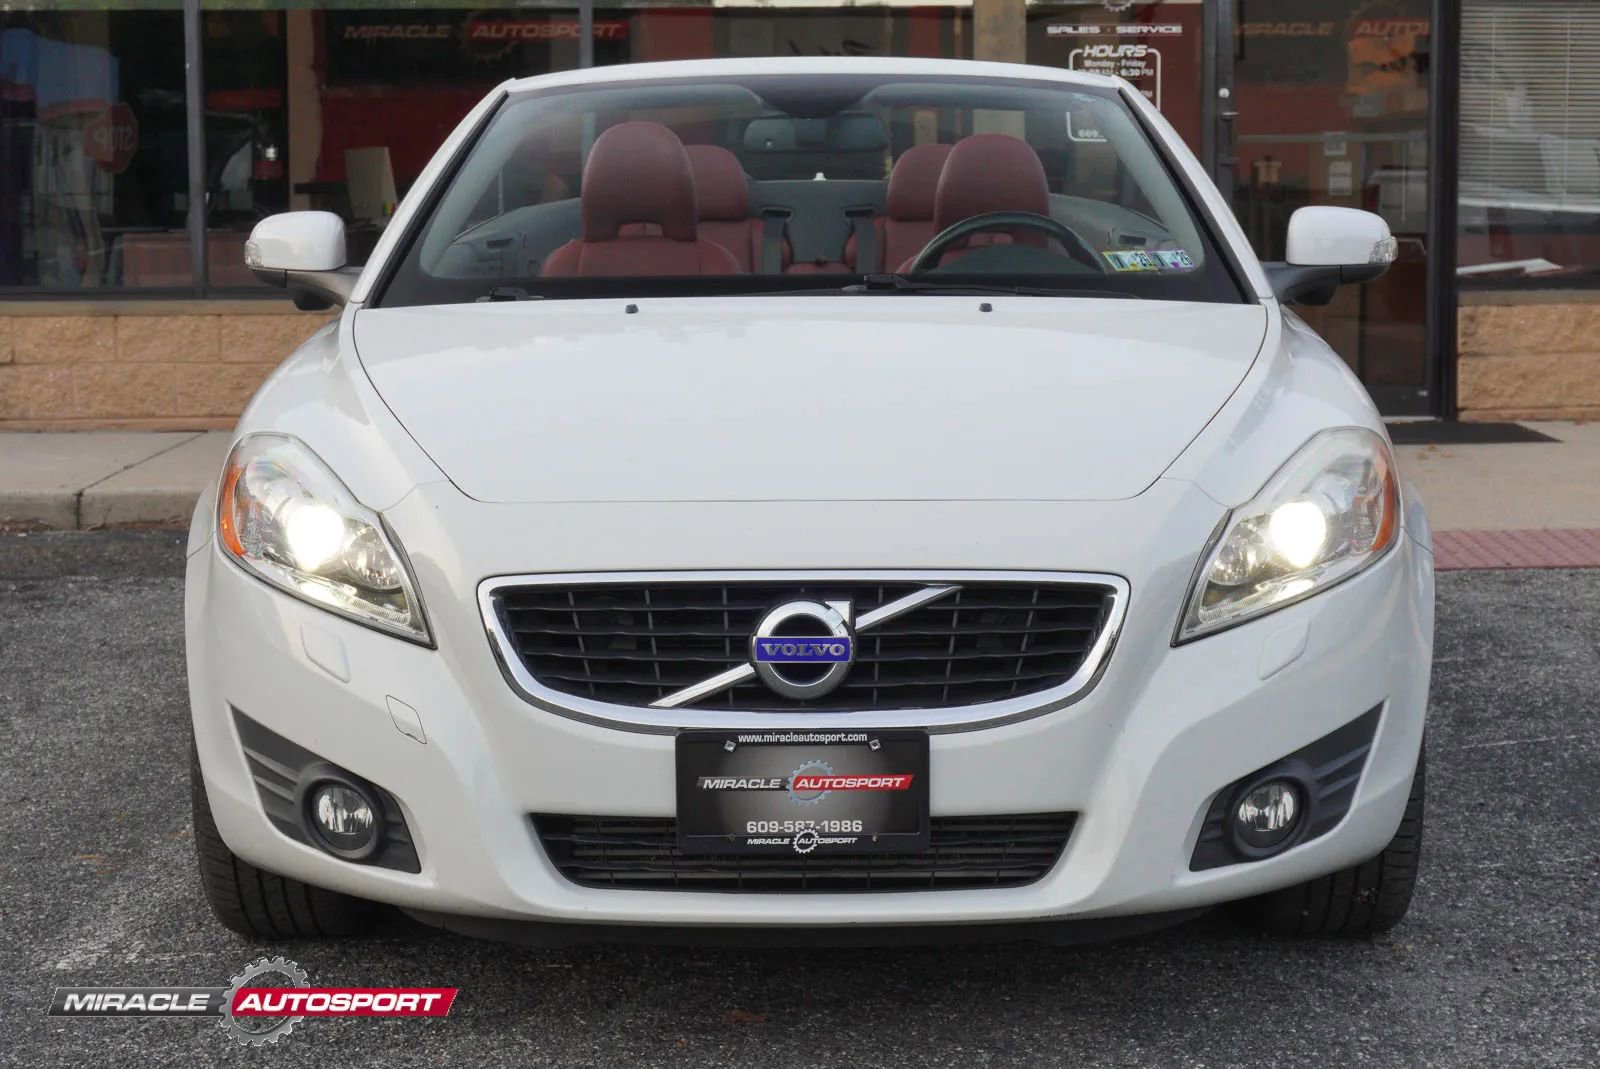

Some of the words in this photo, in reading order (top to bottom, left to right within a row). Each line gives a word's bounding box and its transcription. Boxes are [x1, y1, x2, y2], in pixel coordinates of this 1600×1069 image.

[344, 25, 450, 39] MIRACLE
[1047, 26, 1100, 34] SALES
[1115, 26, 1183, 34] SERVICE
[1354, 20, 1430, 36] AUTO
[1083, 45, 1148, 57] HOURS
[1084, 60, 1115, 69] Monday
[1121, 60, 1146, 69] Friday
[1120, 69, 1140, 77] 6:30
[761, 643, 846, 656] VOLVO
[738, 733, 868, 744] www.miracleautosport.com
[703, 778, 782, 789] MIRACLE
[796, 777, 905, 789] AUTOSPORT
[746, 820, 863, 833] 609-587-1986
[798, 837, 858, 845] AUTOSPORT
